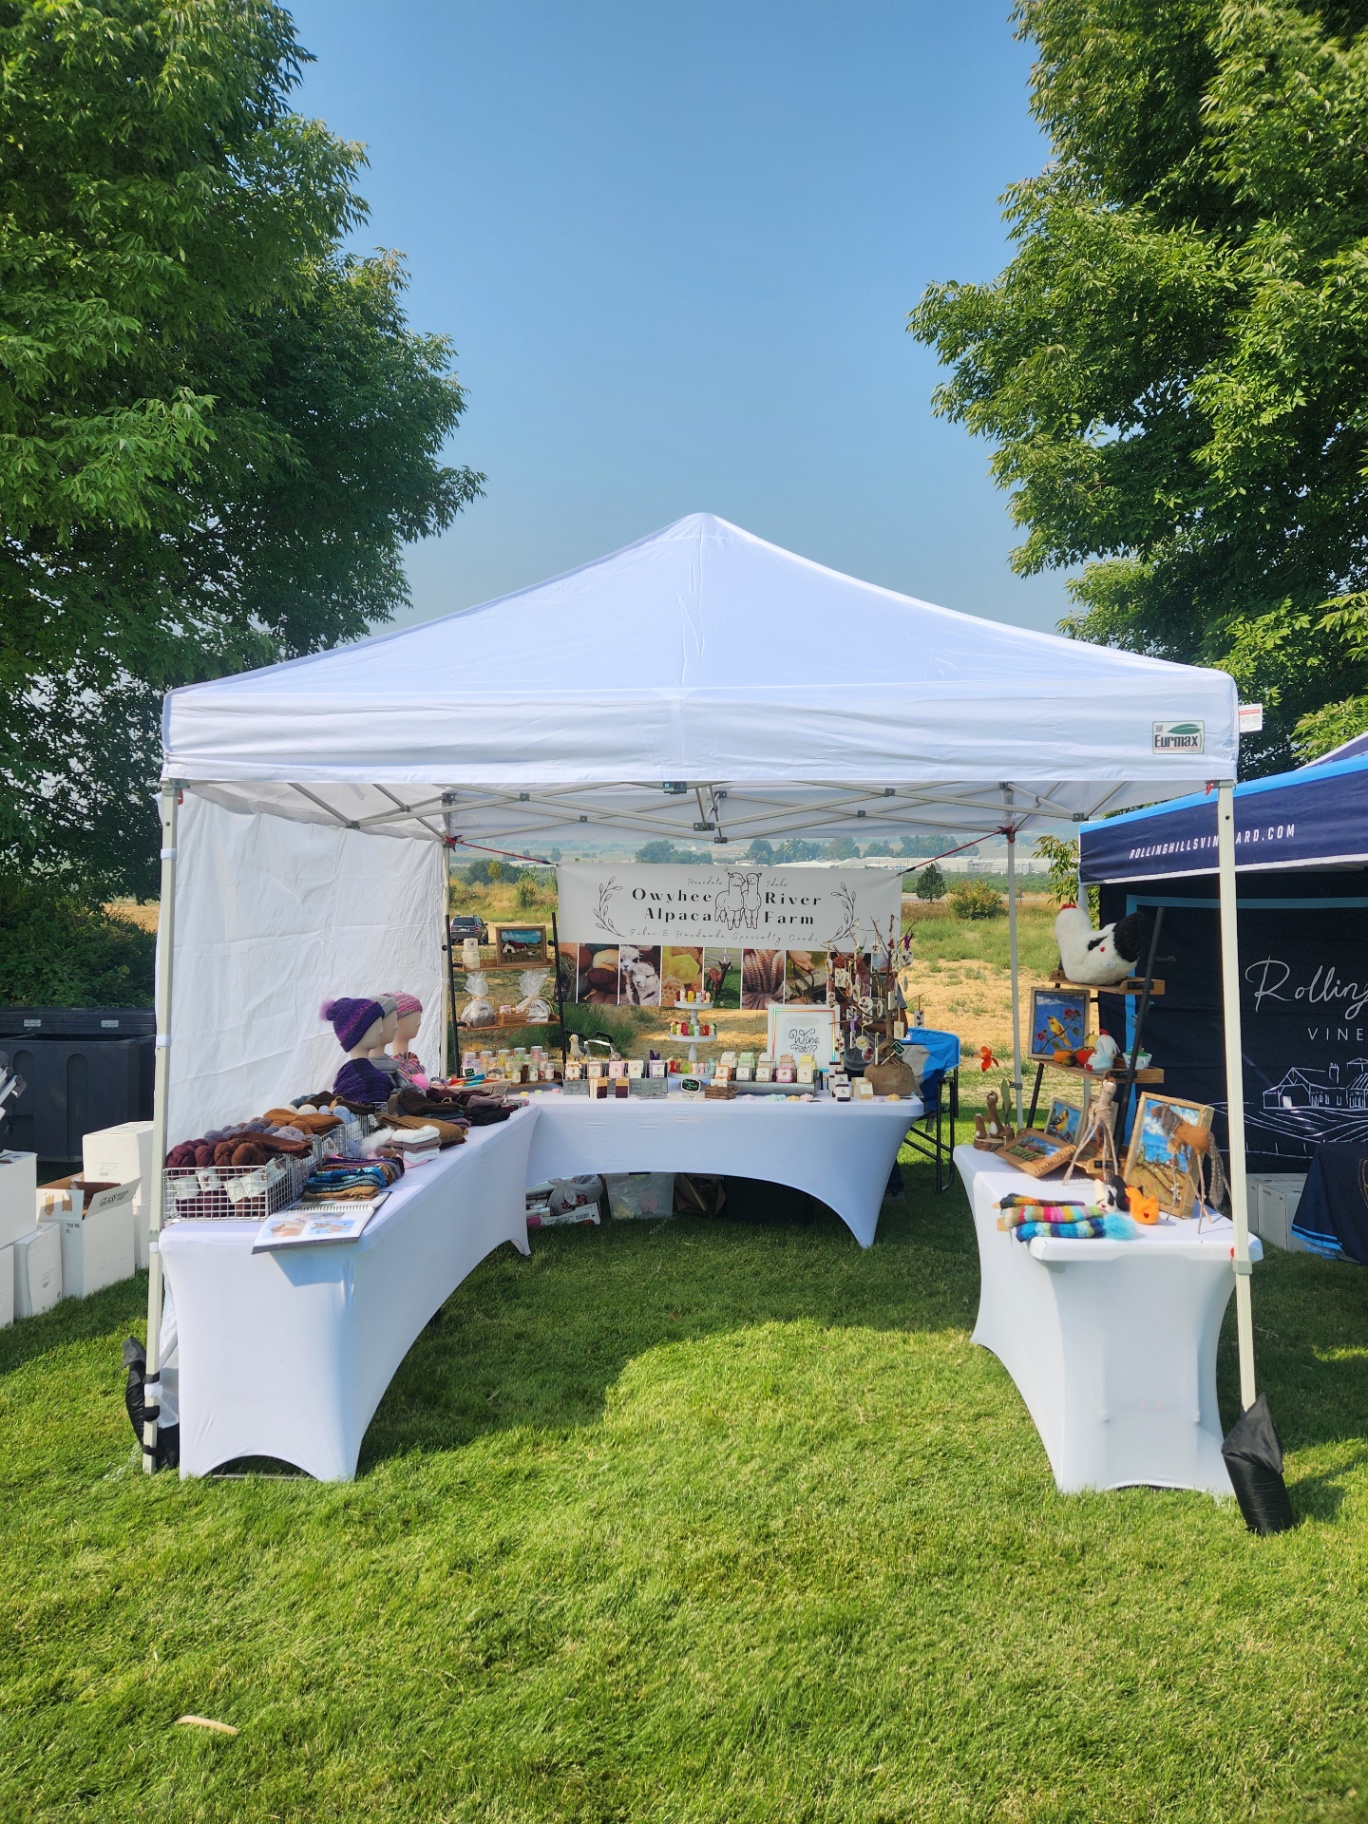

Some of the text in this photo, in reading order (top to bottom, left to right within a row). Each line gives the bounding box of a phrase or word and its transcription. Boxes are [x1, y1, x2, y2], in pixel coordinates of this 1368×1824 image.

[1154, 734, 1199, 748] Eurmax
[1129, 823, 1295, 859] ROLLINGHILLSVINARD.COM
[632, 887, 822, 906] Owyhee River
[644, 907, 814, 925] Alpaca Farm
